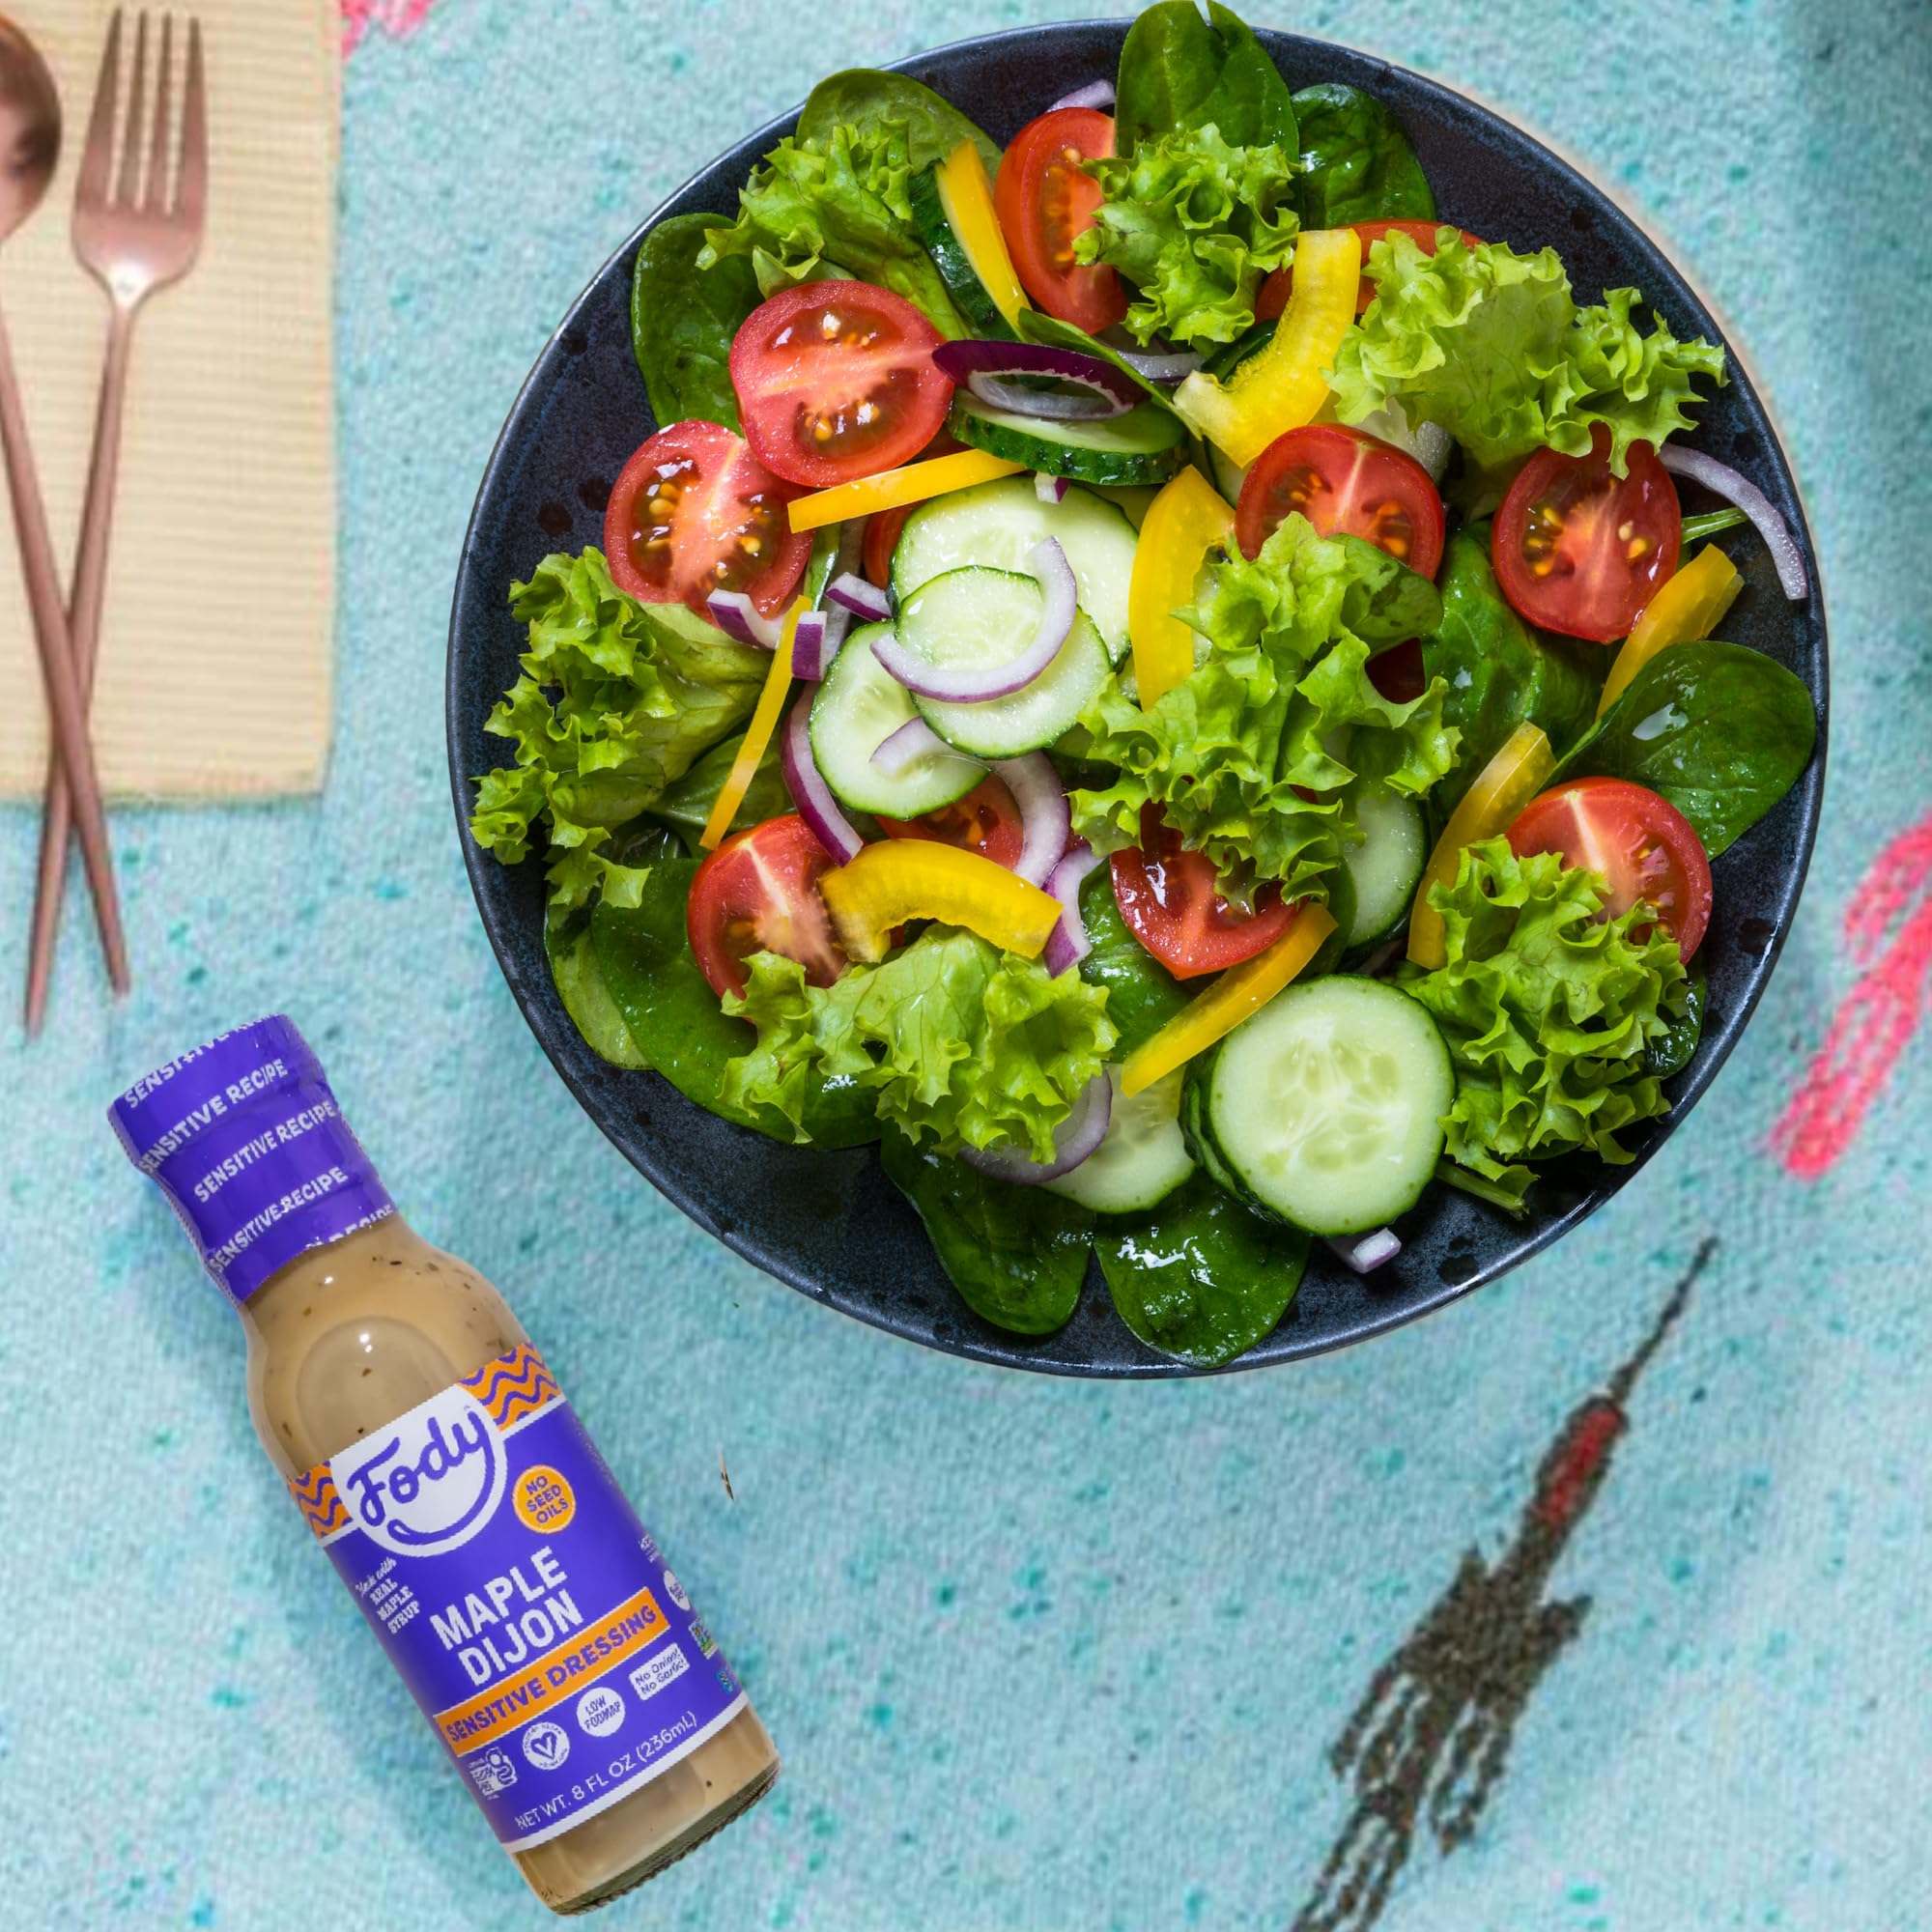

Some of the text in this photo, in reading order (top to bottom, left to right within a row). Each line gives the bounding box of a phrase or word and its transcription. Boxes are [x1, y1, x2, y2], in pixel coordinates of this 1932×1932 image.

[138, 1058, 288, 1173] SENSITIVE RECIPE
[194, 1100, 337, 1203] SENSITIVE RECIPE
[209, 1166, 349, 1273] SENSITIVE RECIPE
[347, 1410, 496, 1546] Fody
[526, 1475, 548, 1495] NO
[526, 1484, 561, 1512] SEED
[536, 1498, 569, 1523] OILS
[370, 1578, 398, 1605] REAL
[377, 1585, 413, 1621] MAPLE
[387, 1601, 420, 1634] SYRUP
[430, 1546, 568, 1651] MAPLE
[458, 1589, 583, 1687] DIJON
[446, 1678, 547, 1743] SENSITIVE
[545, 1605, 657, 1688] DRESSING
[584, 1695, 607, 1717] LOW
[583, 1701, 621, 1730] FODMAP
[515, 1710, 697, 1831] NET WT. 8 FL OZ (236mL)
